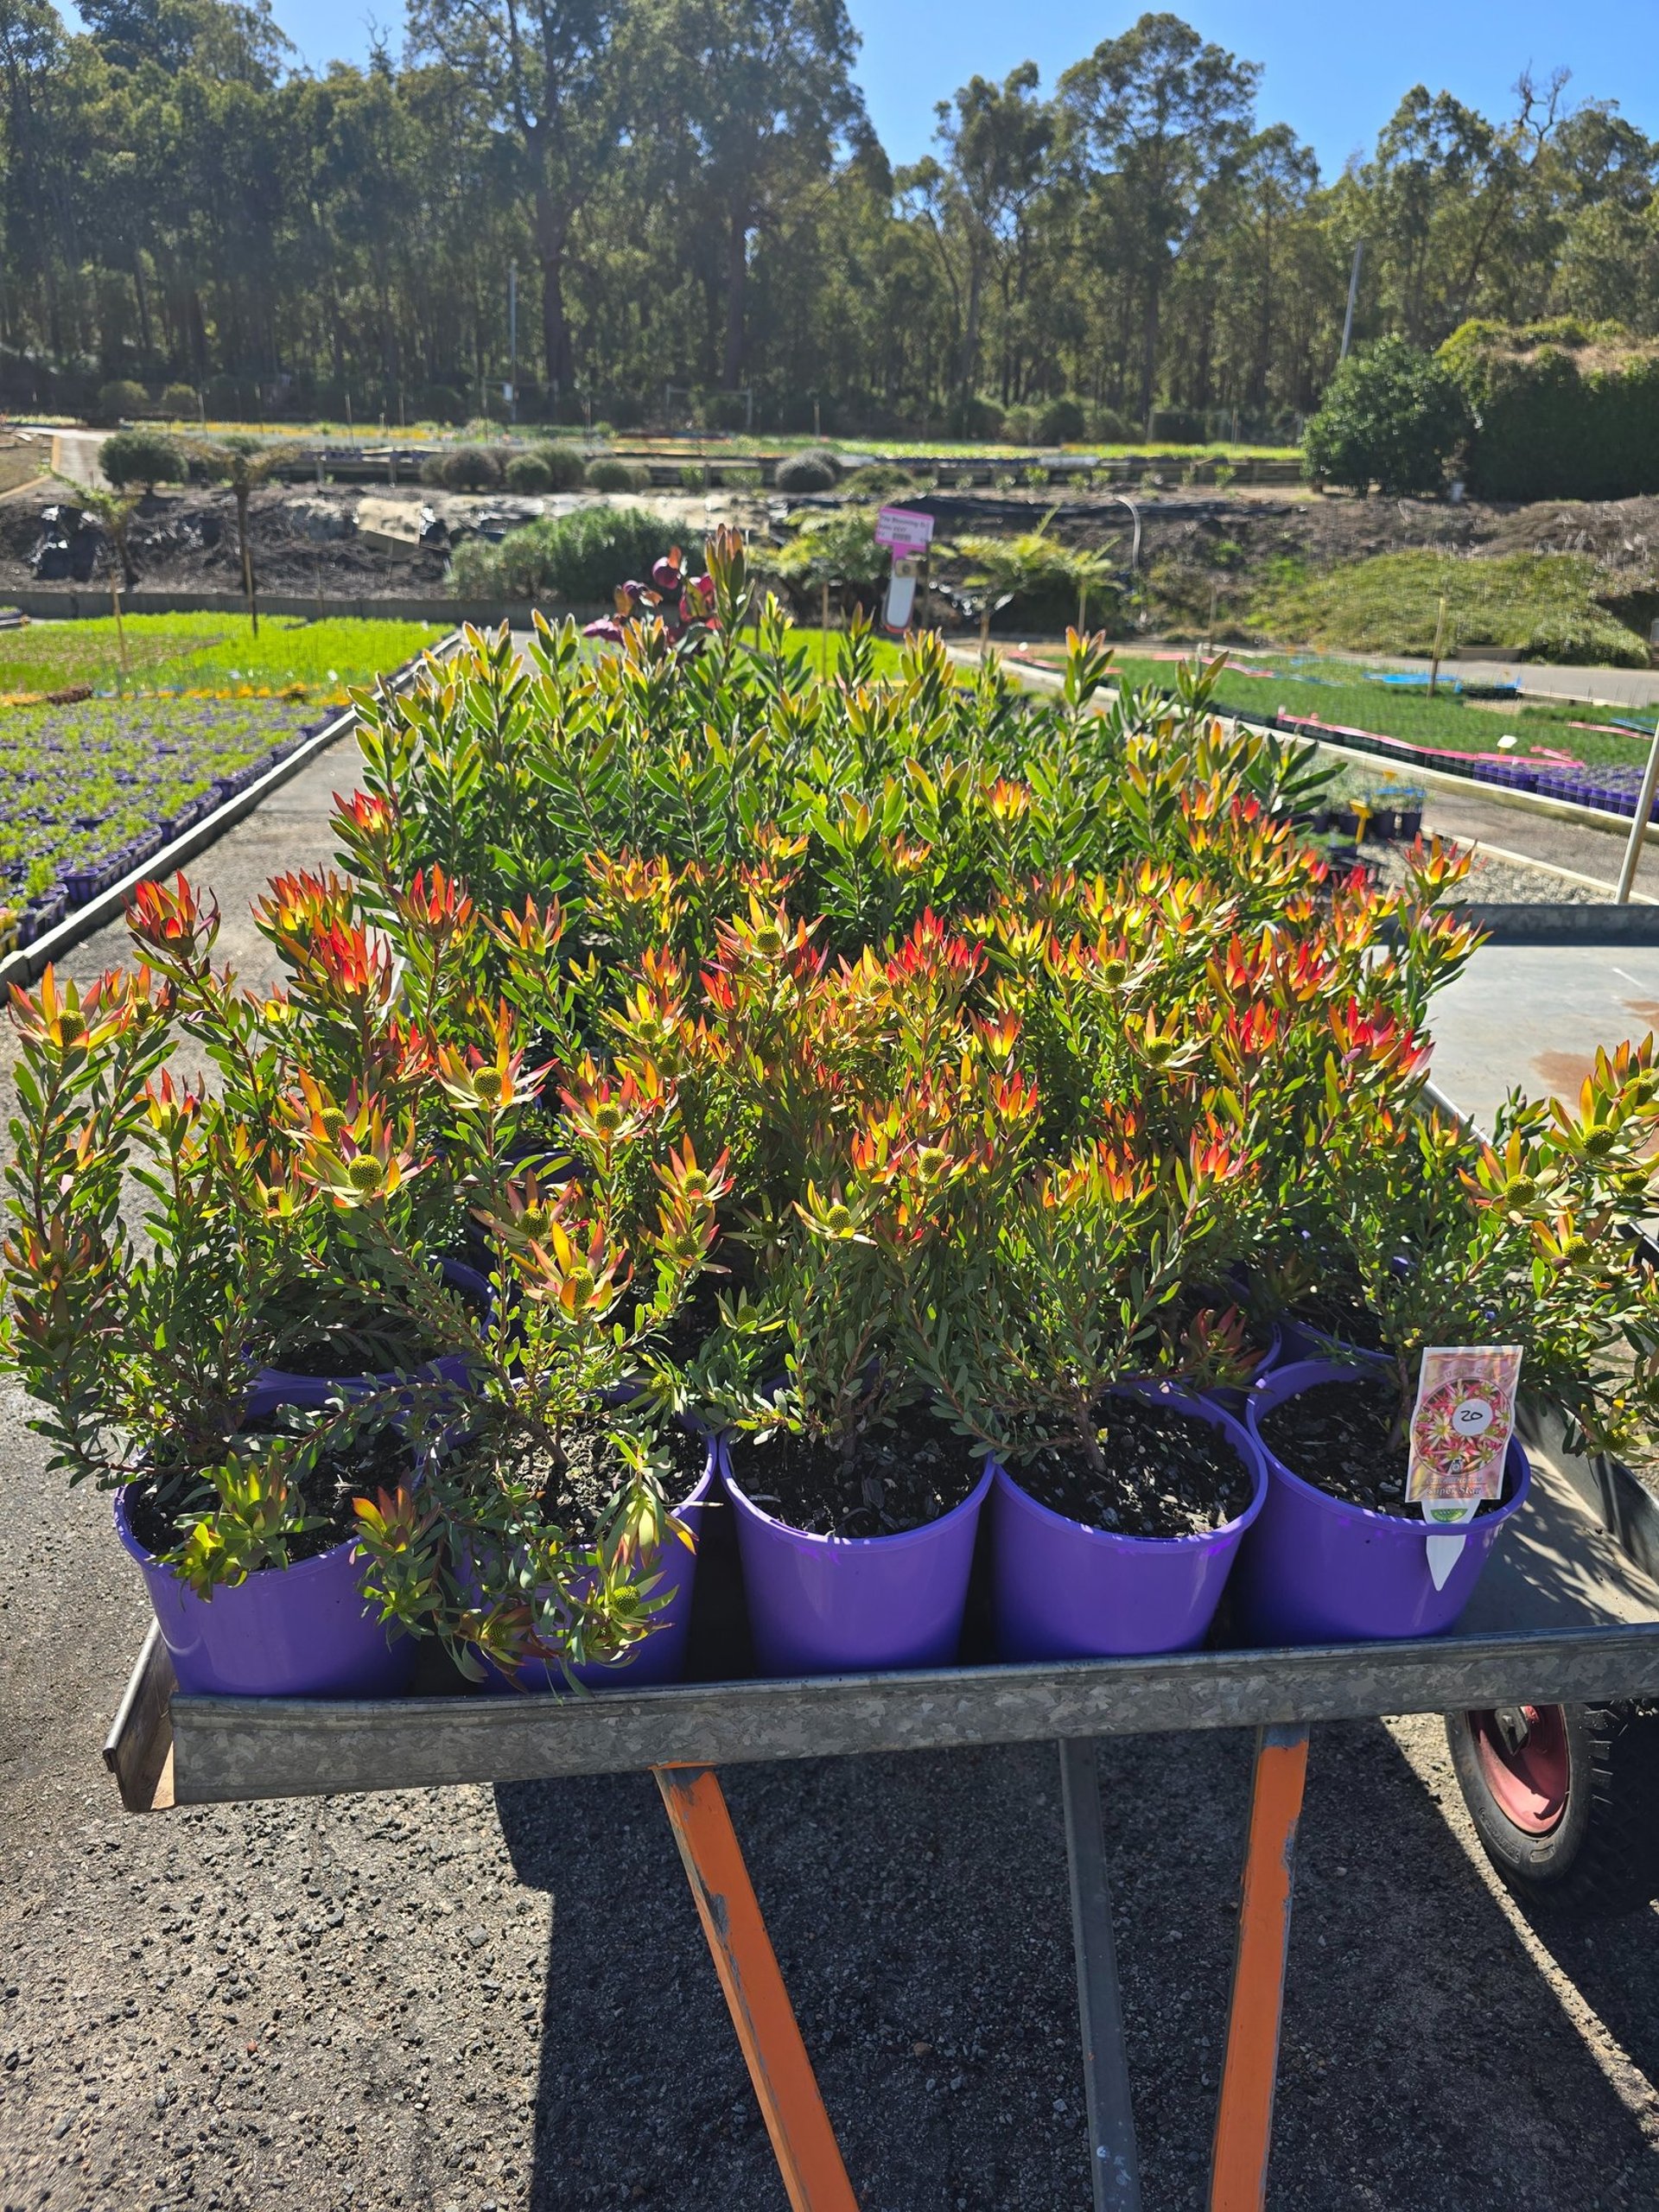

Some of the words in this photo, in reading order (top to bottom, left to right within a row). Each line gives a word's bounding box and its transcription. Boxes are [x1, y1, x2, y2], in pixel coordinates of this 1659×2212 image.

[1460, 1410, 1484, 1422] 20
[1427, 1486, 1456, 1496] Super
[1459, 1485, 1482, 1496] Star
